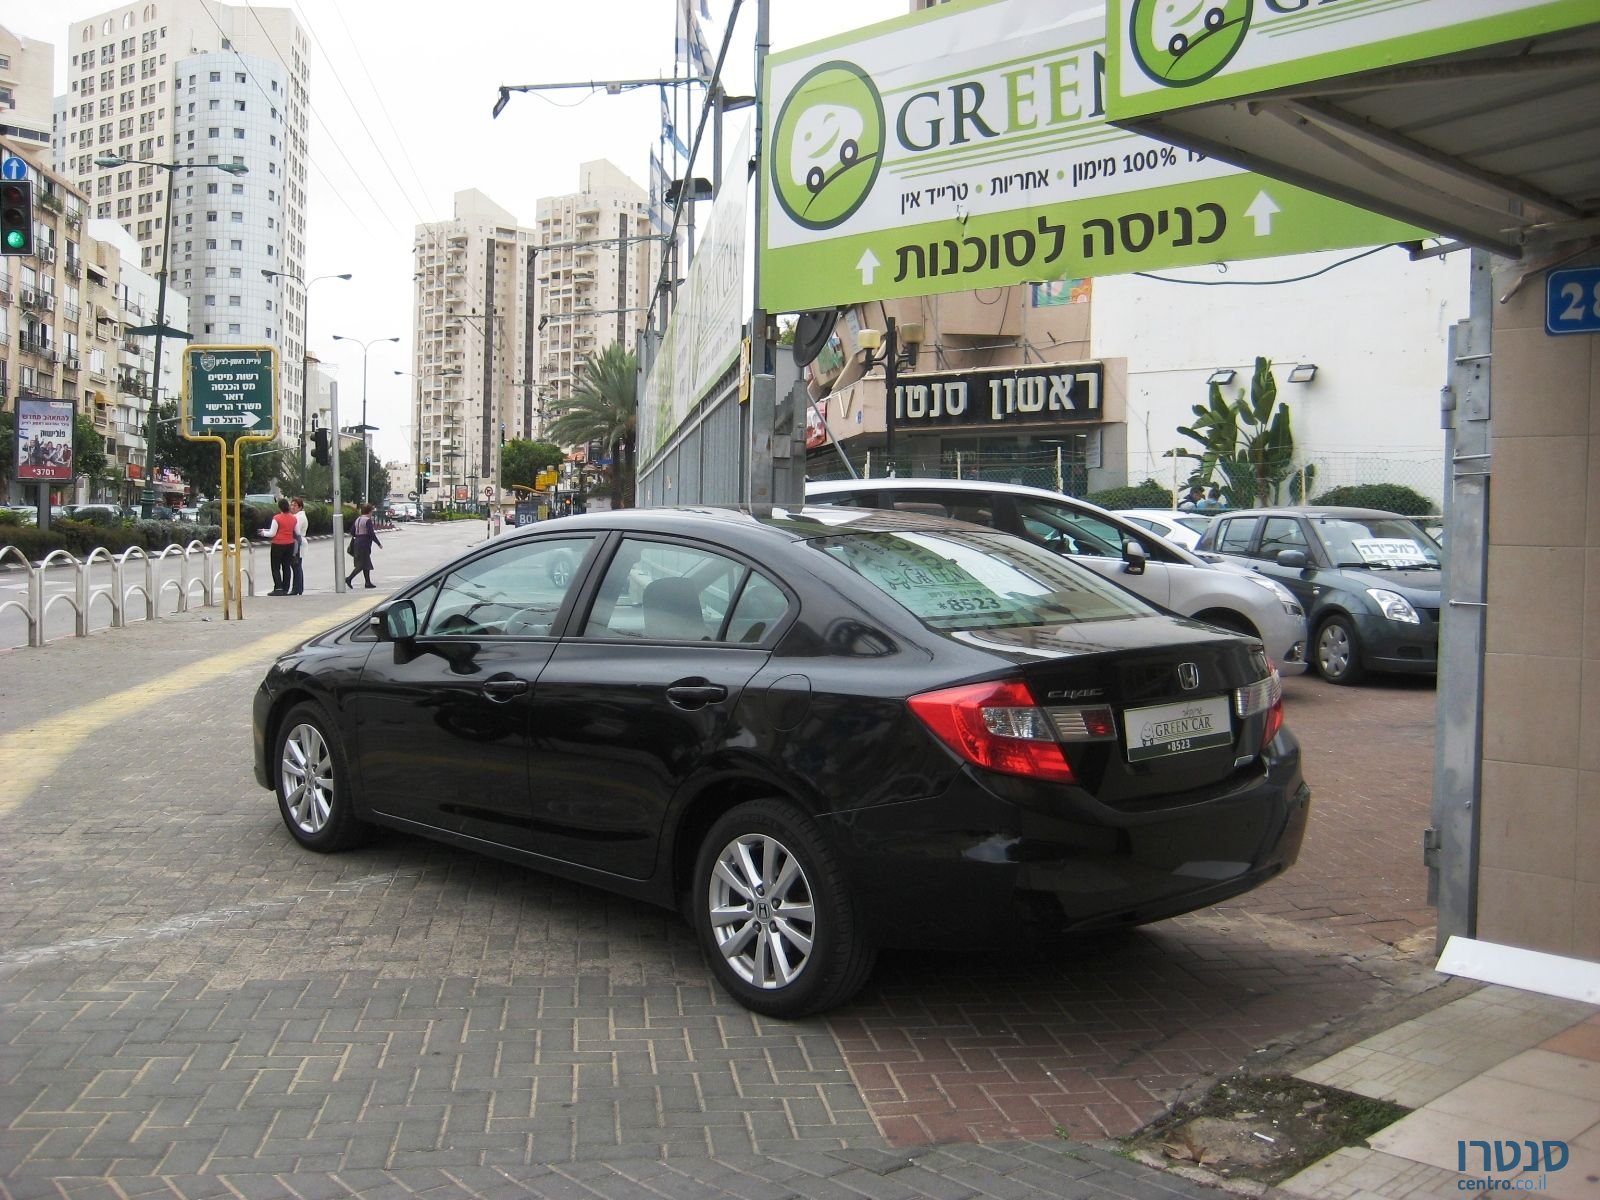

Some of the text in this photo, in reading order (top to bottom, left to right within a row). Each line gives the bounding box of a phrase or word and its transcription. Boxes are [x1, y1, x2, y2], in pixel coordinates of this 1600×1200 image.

[1123, 146, 1177, 174] 100%
[990, 169, 1049, 196] אחריות
[1072, 156, 1116, 187] מימון
[901, 191, 921, 214] אין
[925, 182, 968, 206] טרייד
[893, 202, 1226, 283] כניסה לסוכנות
[208, 373, 259, 381] רשות מיסים
[211, 383, 256, 391] מס הכנסה
[223, 393, 244, 401] דואר
[988, 371, 1098, 420] ראשון
[205, 403, 262, 411] משרד הרישוי
[223, 416, 243, 424] הרצל
[1360, 543, 1418, 555] למכירה
[1155, 716, 1212, 737] GREEN CAR
